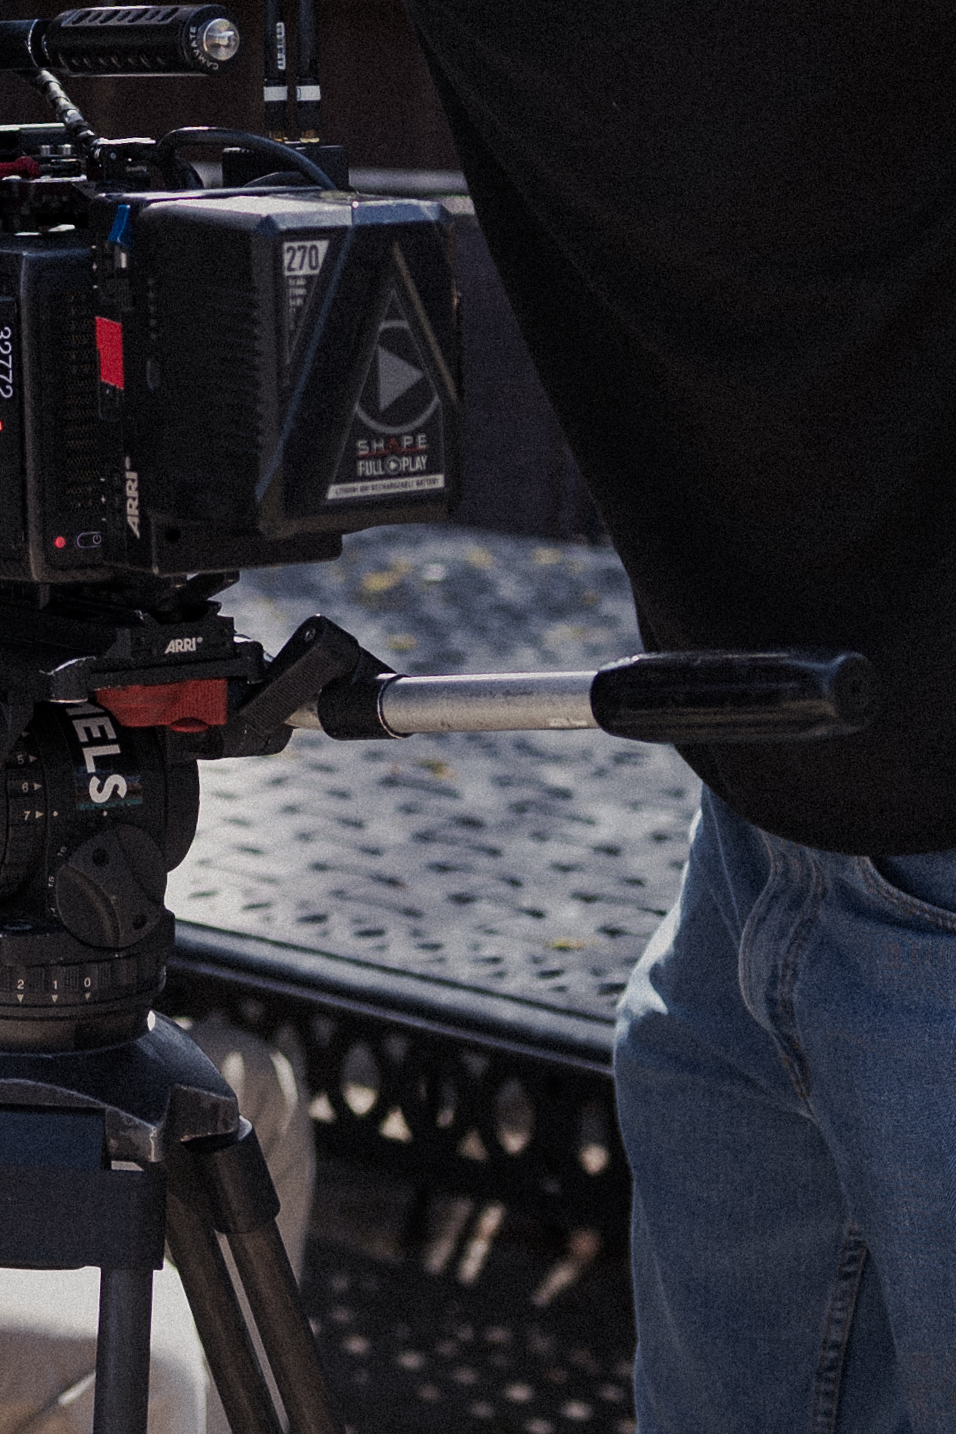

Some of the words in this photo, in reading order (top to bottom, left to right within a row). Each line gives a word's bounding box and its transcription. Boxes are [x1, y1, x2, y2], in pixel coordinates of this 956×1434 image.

[287, 245, 320, 272] 270
[356, 434, 429, 455] SHAPE
[357, 458, 385, 477] FULL
[401, 455, 429, 473] PLAY
[125, 470, 141, 539] ARRI
[164, 637, 197, 655] ARRI
[16, 754, 25, 765] 5
[20, 781, 29, 793] 6
[22, 810, 31, 821] 7
